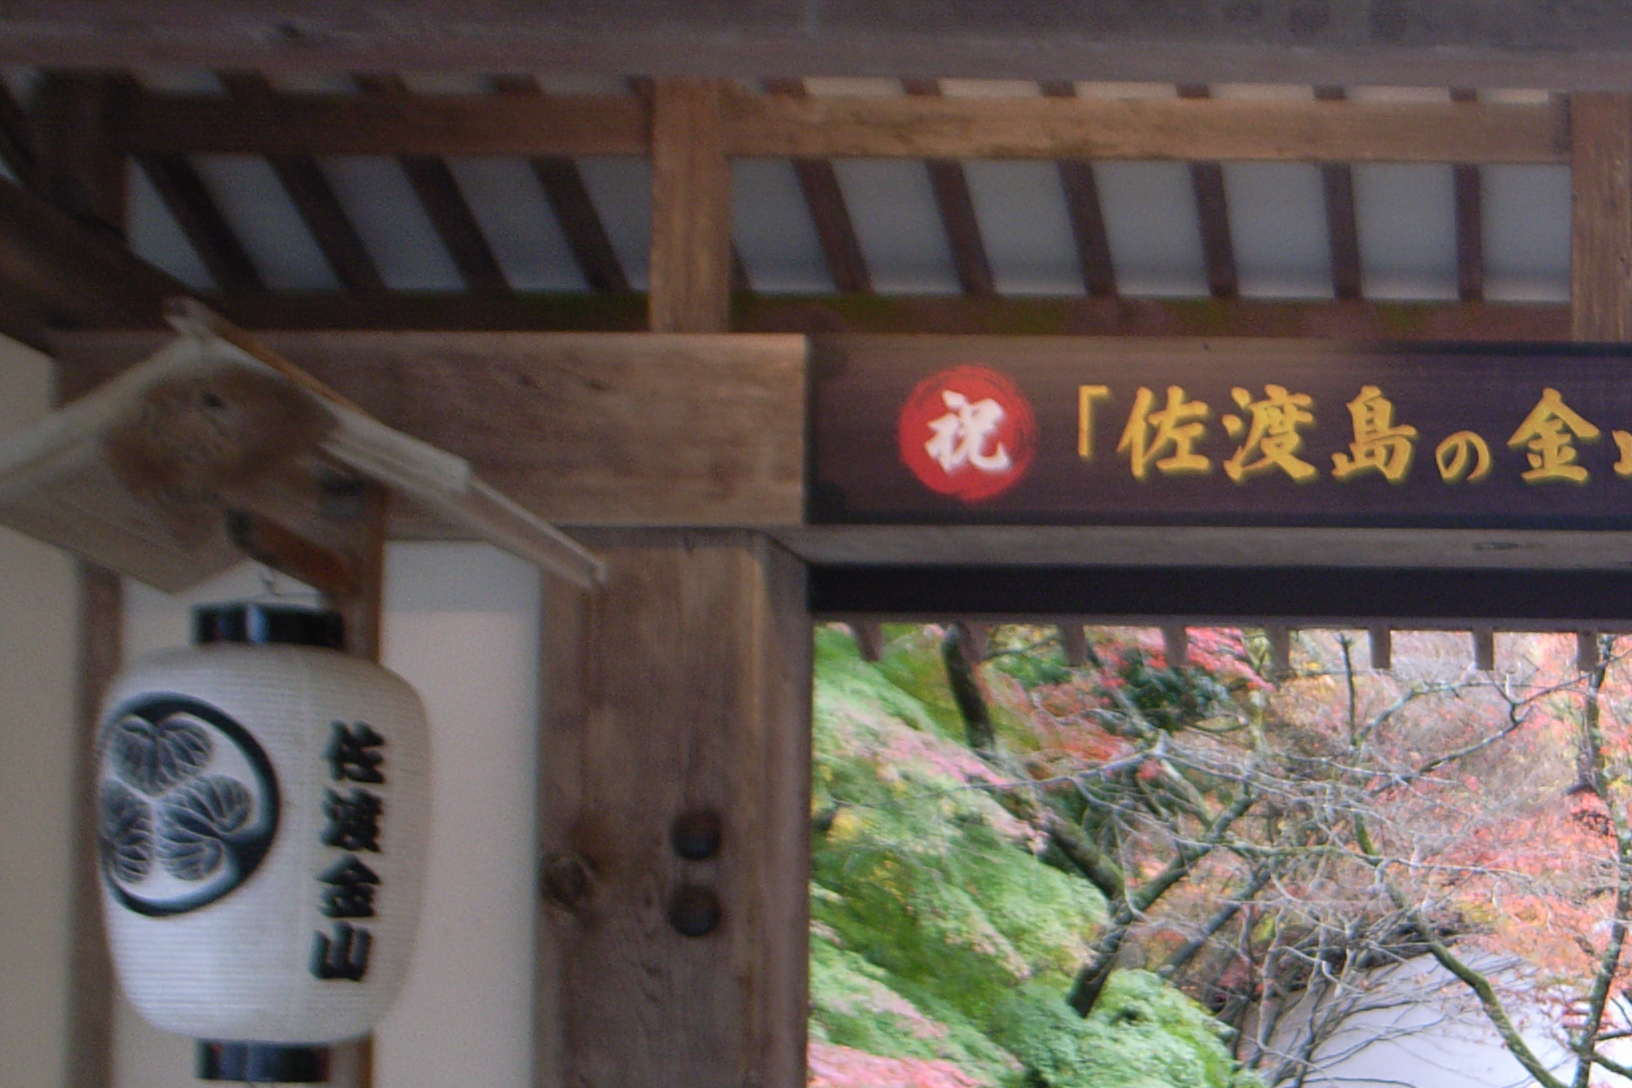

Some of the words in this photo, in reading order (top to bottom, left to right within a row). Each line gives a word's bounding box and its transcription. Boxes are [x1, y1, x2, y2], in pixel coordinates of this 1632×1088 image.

[924, 389, 1012, 474] 祝
[309, 719, 387, 980] 佐渡金山
